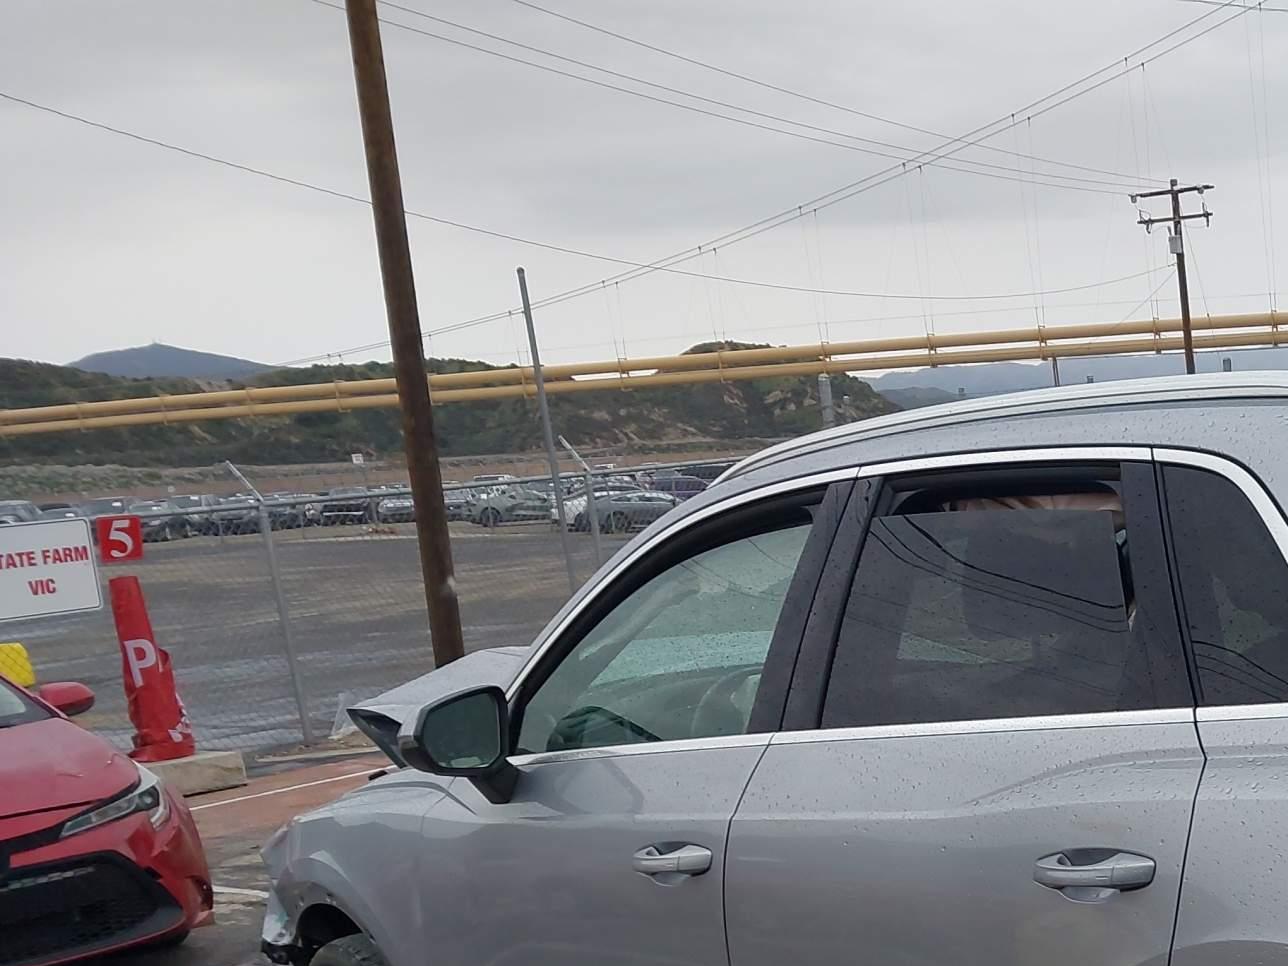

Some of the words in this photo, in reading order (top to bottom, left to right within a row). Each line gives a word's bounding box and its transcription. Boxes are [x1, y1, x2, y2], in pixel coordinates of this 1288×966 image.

[108, 519, 134, 558] 5
[41, 545, 89, 566] FARM
[27, 578, 57, 596] VIC
[123, 638, 164, 688] P
